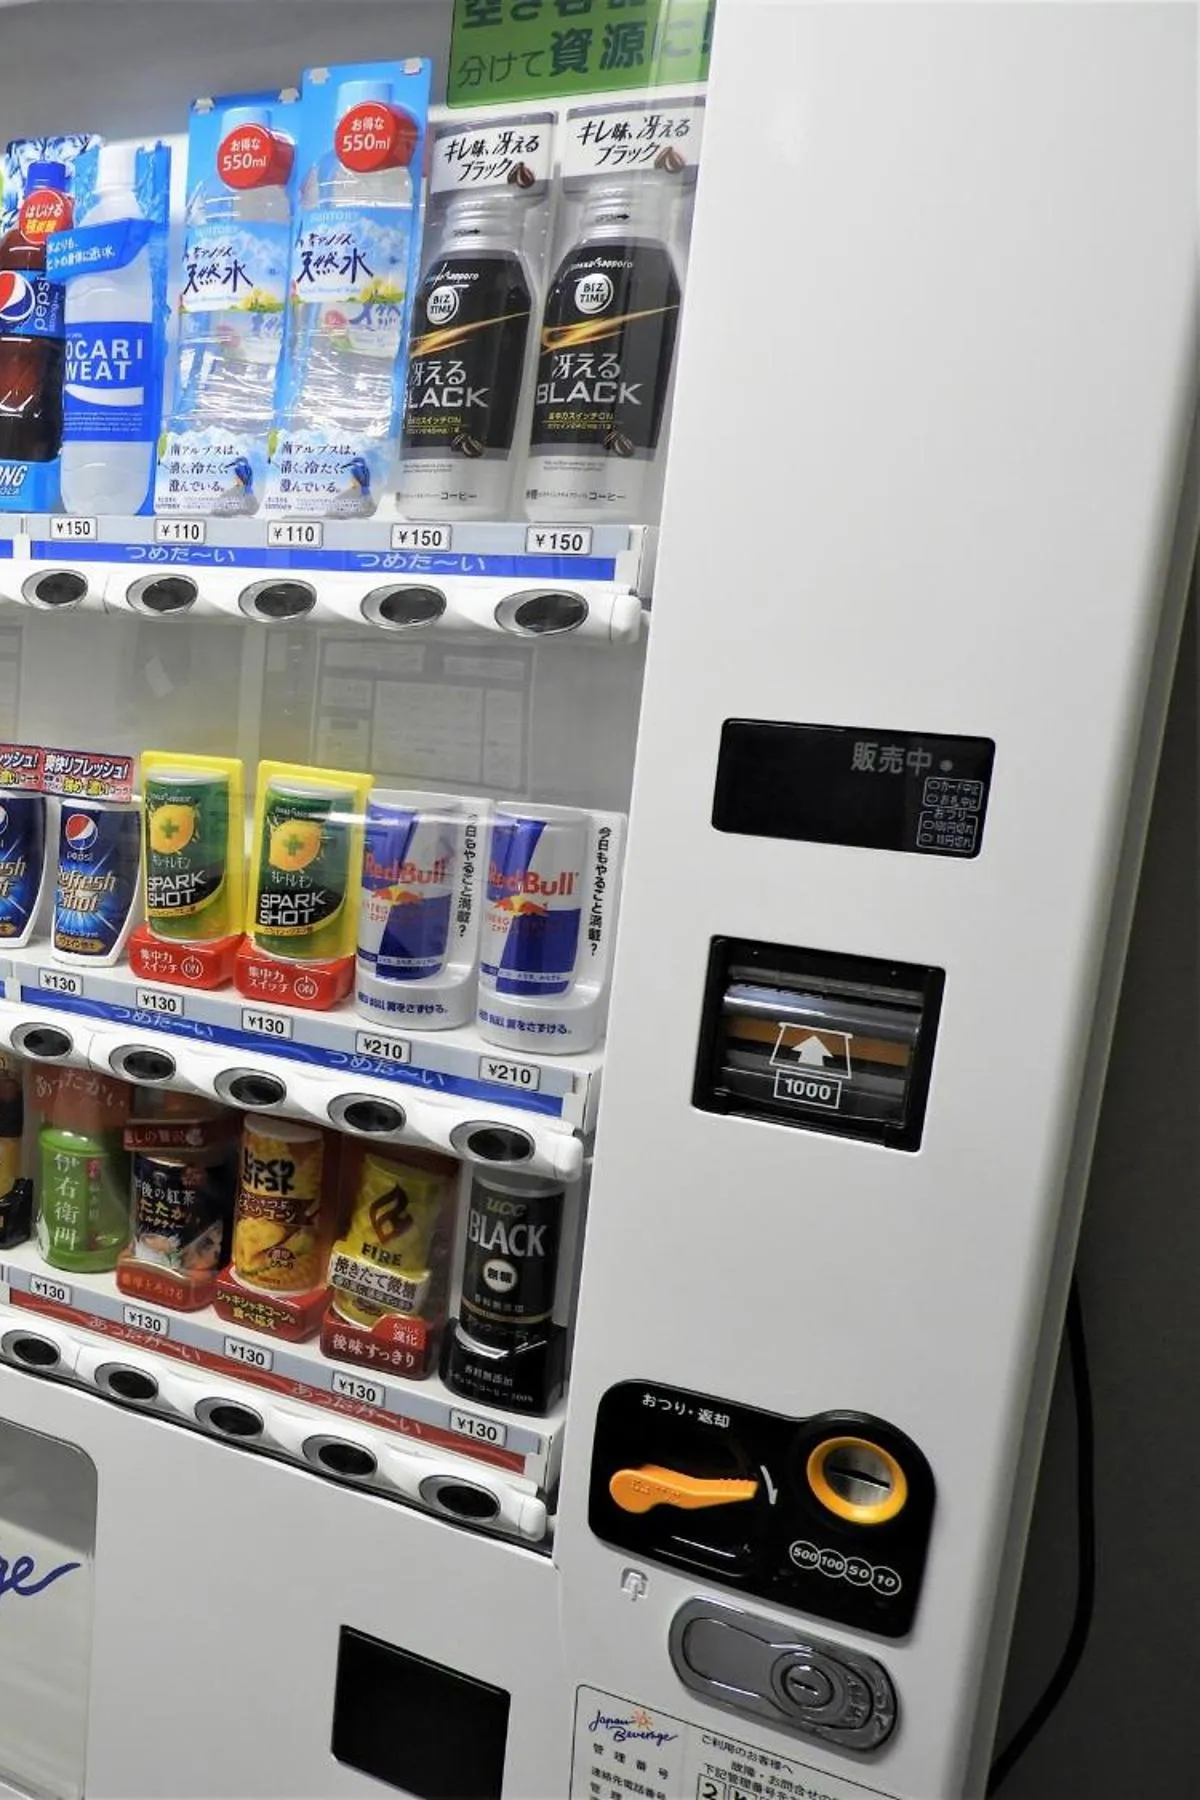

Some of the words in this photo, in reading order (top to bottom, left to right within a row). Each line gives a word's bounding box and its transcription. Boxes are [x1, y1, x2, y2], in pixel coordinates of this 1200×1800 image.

[351, 116, 385, 131] お得な
[576, 115, 692, 147] キレ味、冴える
[231, 138, 261, 151] お得な
[342, 134, 392, 153] 550ml
[444, 131, 540, 164] キレ味、冴える
[594, 141, 661, 167] ブラック
[223, 153, 267, 171] 550ml
[457, 156, 513, 183] ブラック
[582, 281, 605, 294] BIZ
[34, 276, 51, 331] pepsi
[551, 352, 622, 380] 冴える
[536, 381, 644, 406] BLACK
[56, 521, 91, 536] ¥150
[161, 524, 200, 540] ¥110
[273, 526, 314, 542] ¥110
[399, 529, 442, 547] ¥150
[535, 533, 584, 551] ¥150
[44, 754, 129, 779] 爽快リフレッシュ!
[851, 741, 934, 776] 販売中
[147, 870, 207, 891] SPARK
[147, 889, 197, 907] SHOT
[260, 891, 327, 910] SPARK
[258, 907, 315, 926] SHOT
[43, 974, 77, 992] ¥130
[141, 994, 177, 1012] ¥130
[248, 1015, 285, 1034] ¥130
[363, 1038, 403, 1059] ¥210
[488, 1063, 531, 1084] ¥210
[784, 1077, 832, 1101] 1000
[467, 1208, 548, 1257] BLACK
[361, 1243, 402, 1266] FIRE
[34, 1282, 65, 1301] ¥130
[128, 1313, 161, 1332] ¥130
[230, 1345, 265, 1365] ¥130
[332, 1333, 415, 1367] 後味すっきり
[338, 1379, 376, 1402] ¥130
[642, 1392, 731, 1429] おつり・返却
[456, 1417, 498, 1442] ¥130
[792, 1546, 818, 1565] 500
[820, 1555, 845, 1572] 100
[848, 1563, 870, 1580] 50
[877, 1574, 896, 1588] 10
[588, 1709, 635, 1732] Japan
[607, 1726, 679, 1747] Beverage
